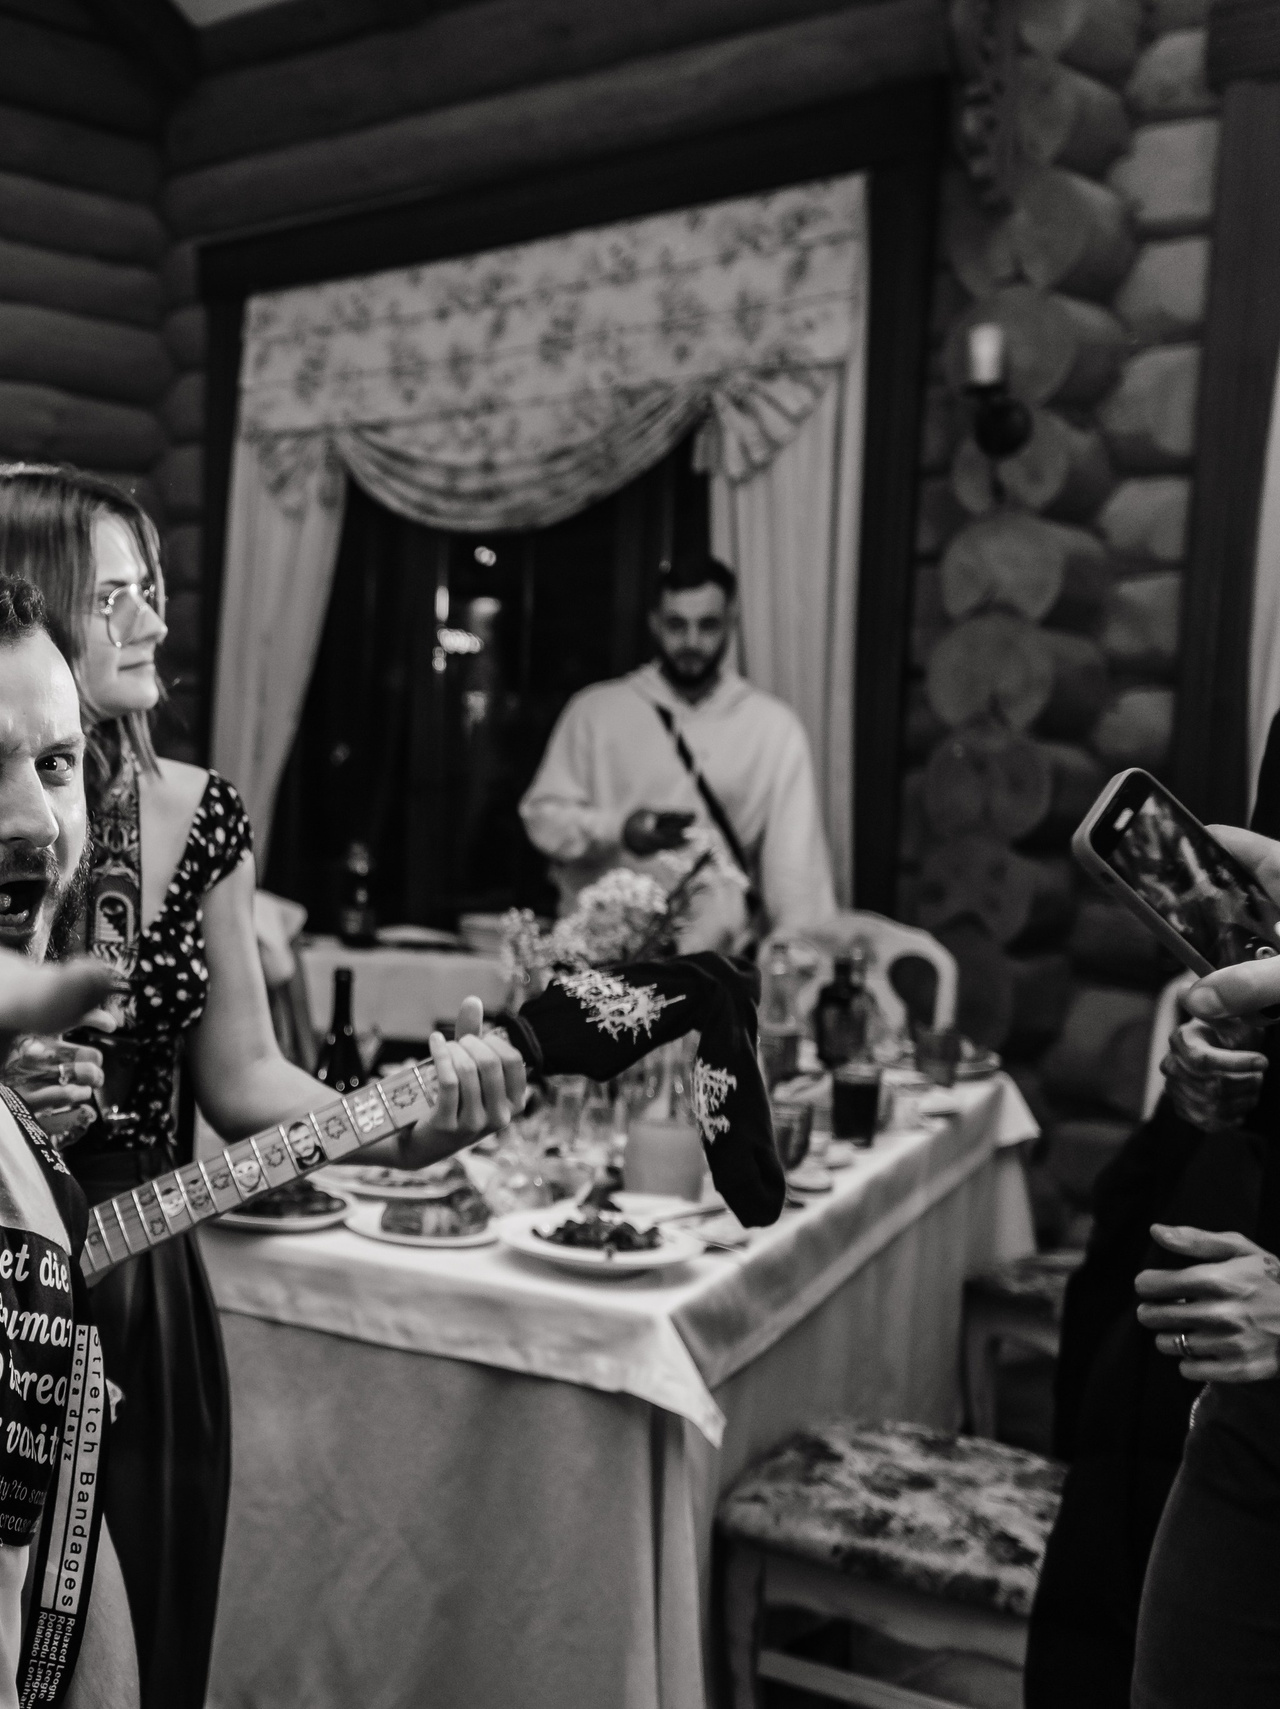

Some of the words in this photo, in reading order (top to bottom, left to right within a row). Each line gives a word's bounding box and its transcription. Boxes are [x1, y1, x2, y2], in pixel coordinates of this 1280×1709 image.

[71, 1328, 86, 1396] zucca
[63, 1409, 80, 1462] dayz
[61, 1471, 96, 1608] Bandages
[49, 1615, 66, 1661] Relaxed
[58, 1617, 76, 1663] Relaxed
